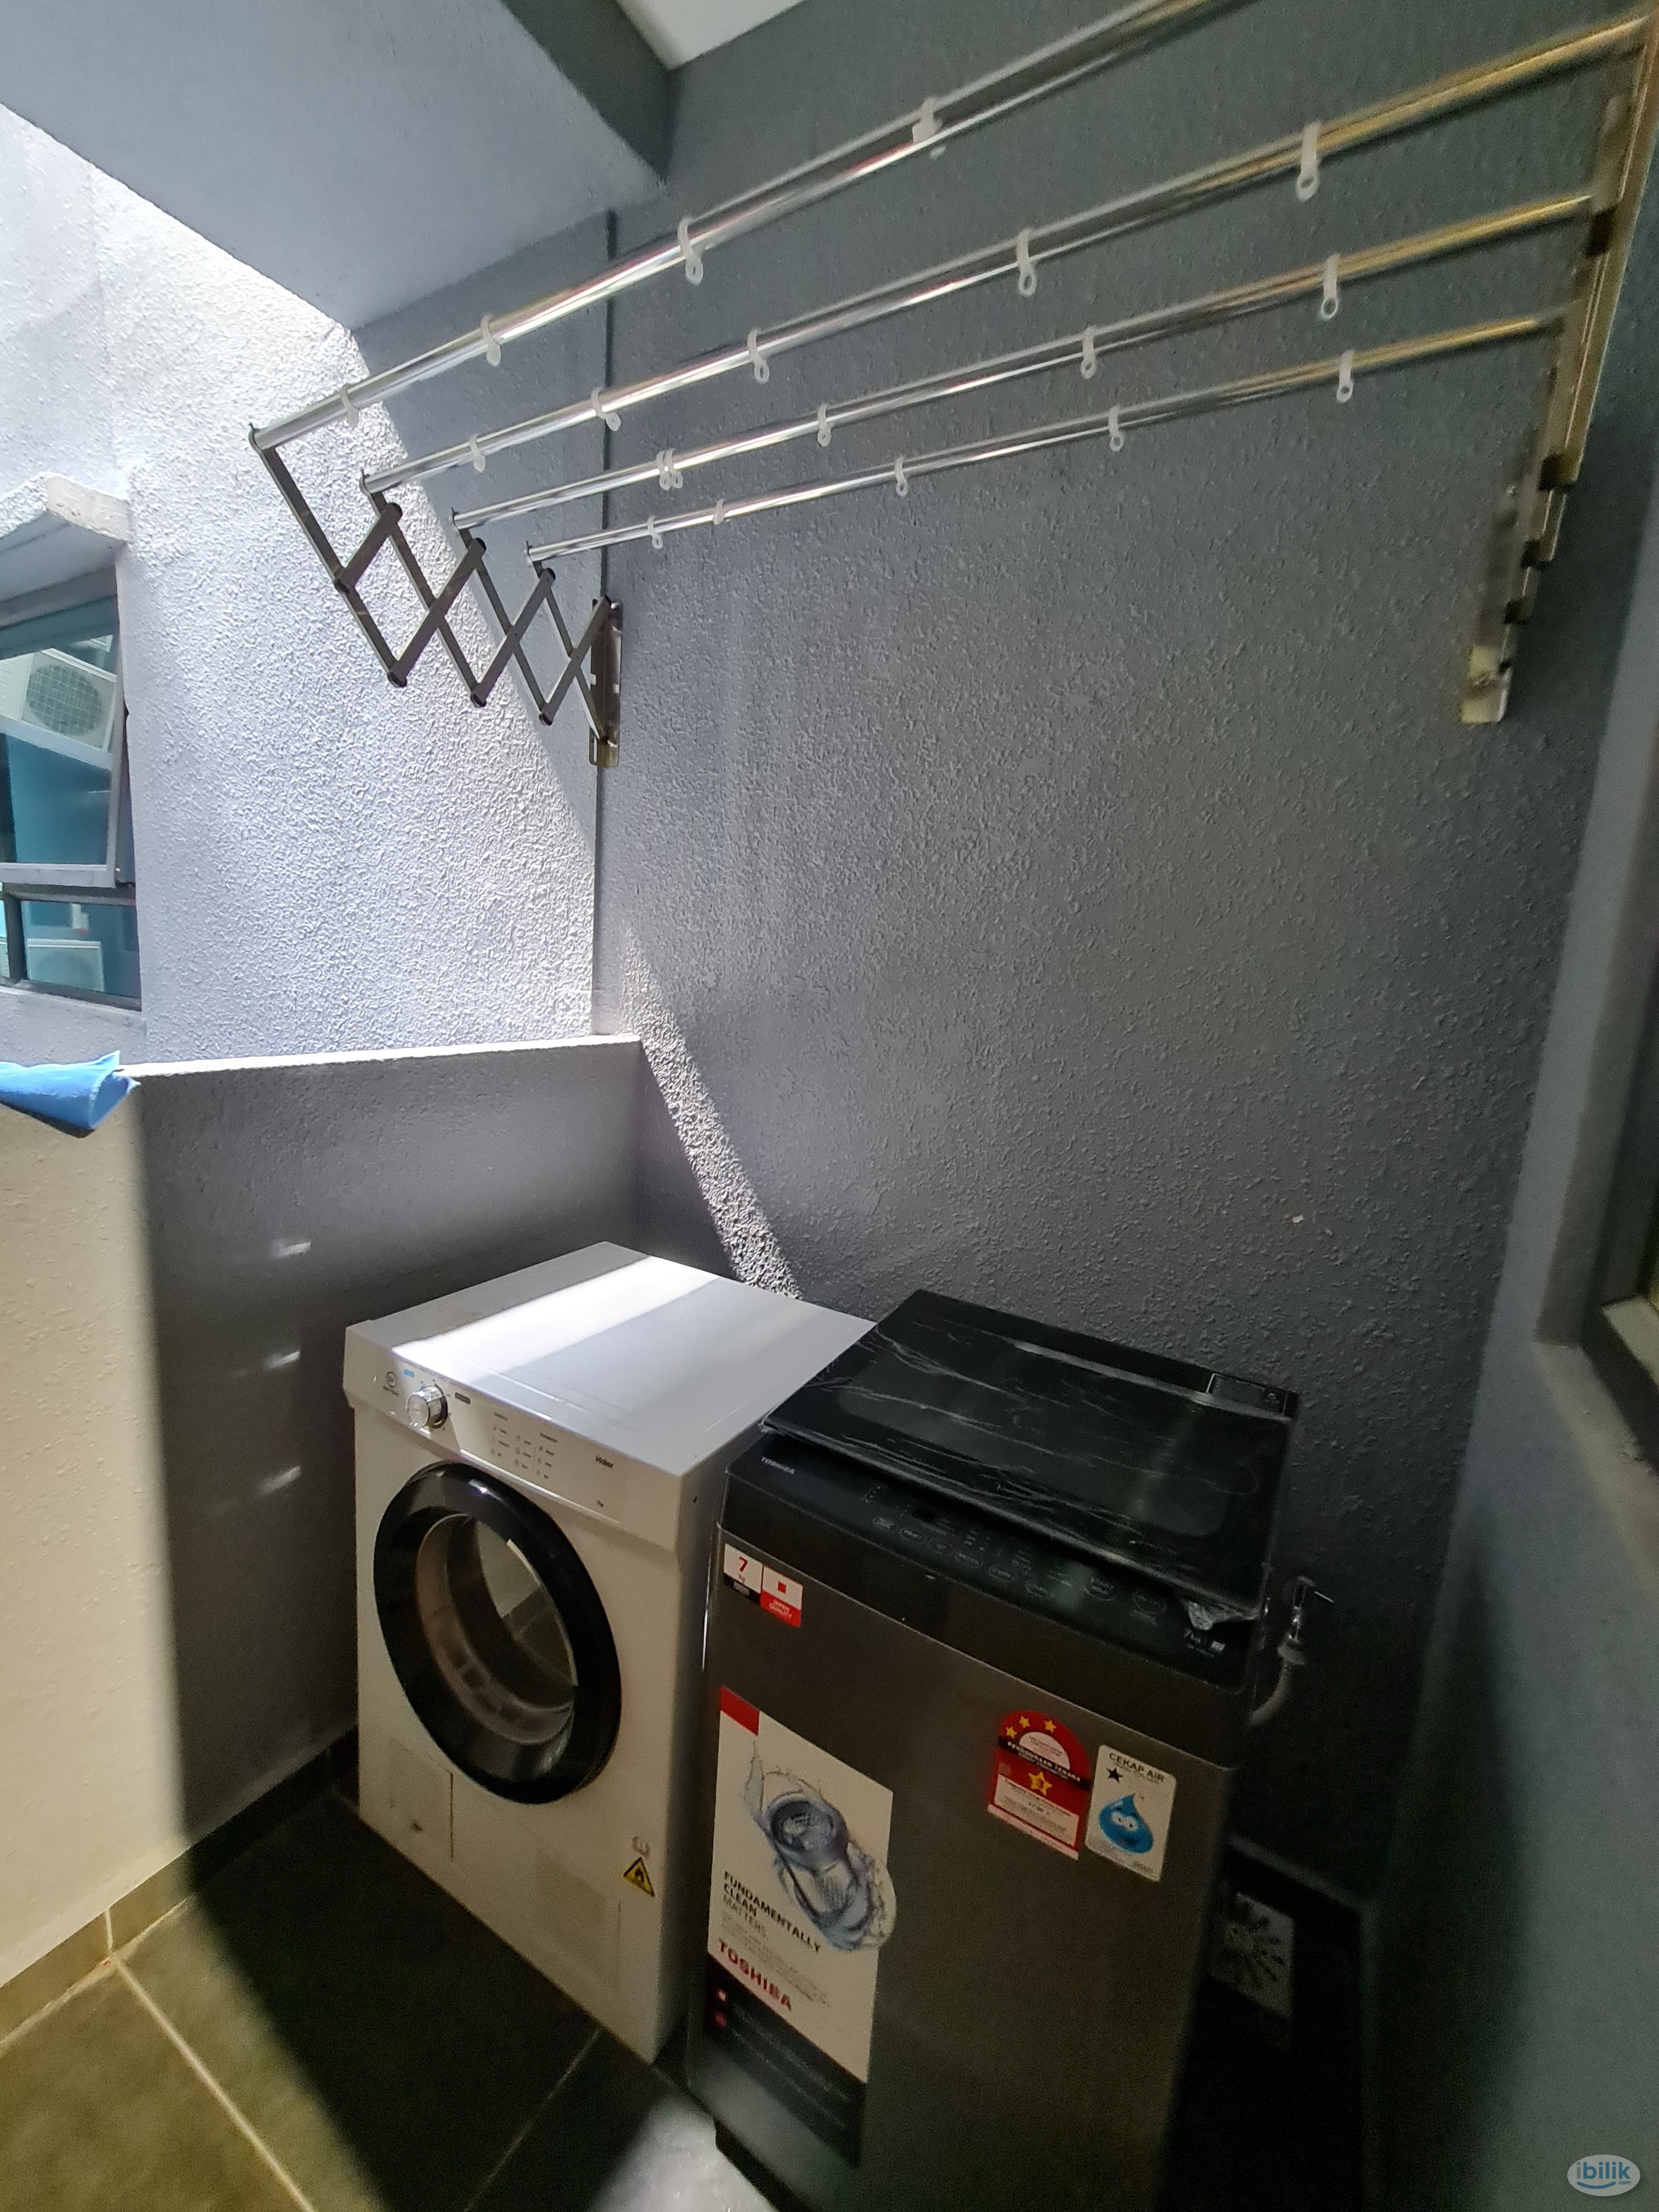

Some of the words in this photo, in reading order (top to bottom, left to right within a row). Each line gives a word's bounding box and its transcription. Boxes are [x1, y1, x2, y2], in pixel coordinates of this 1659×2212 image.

[761, 1456, 795, 1475] TOSHIBA
[738, 1556, 748, 1572] 7
[1109, 1752, 1146, 1773] CEKAP
[1147, 1769, 1165, 1782] AIR
[724, 1882, 757, 1917] CLEAN
[724, 1870, 821, 1953] FUNDAMENTALLY
[718, 1938, 792, 2012] TOSHIBA
